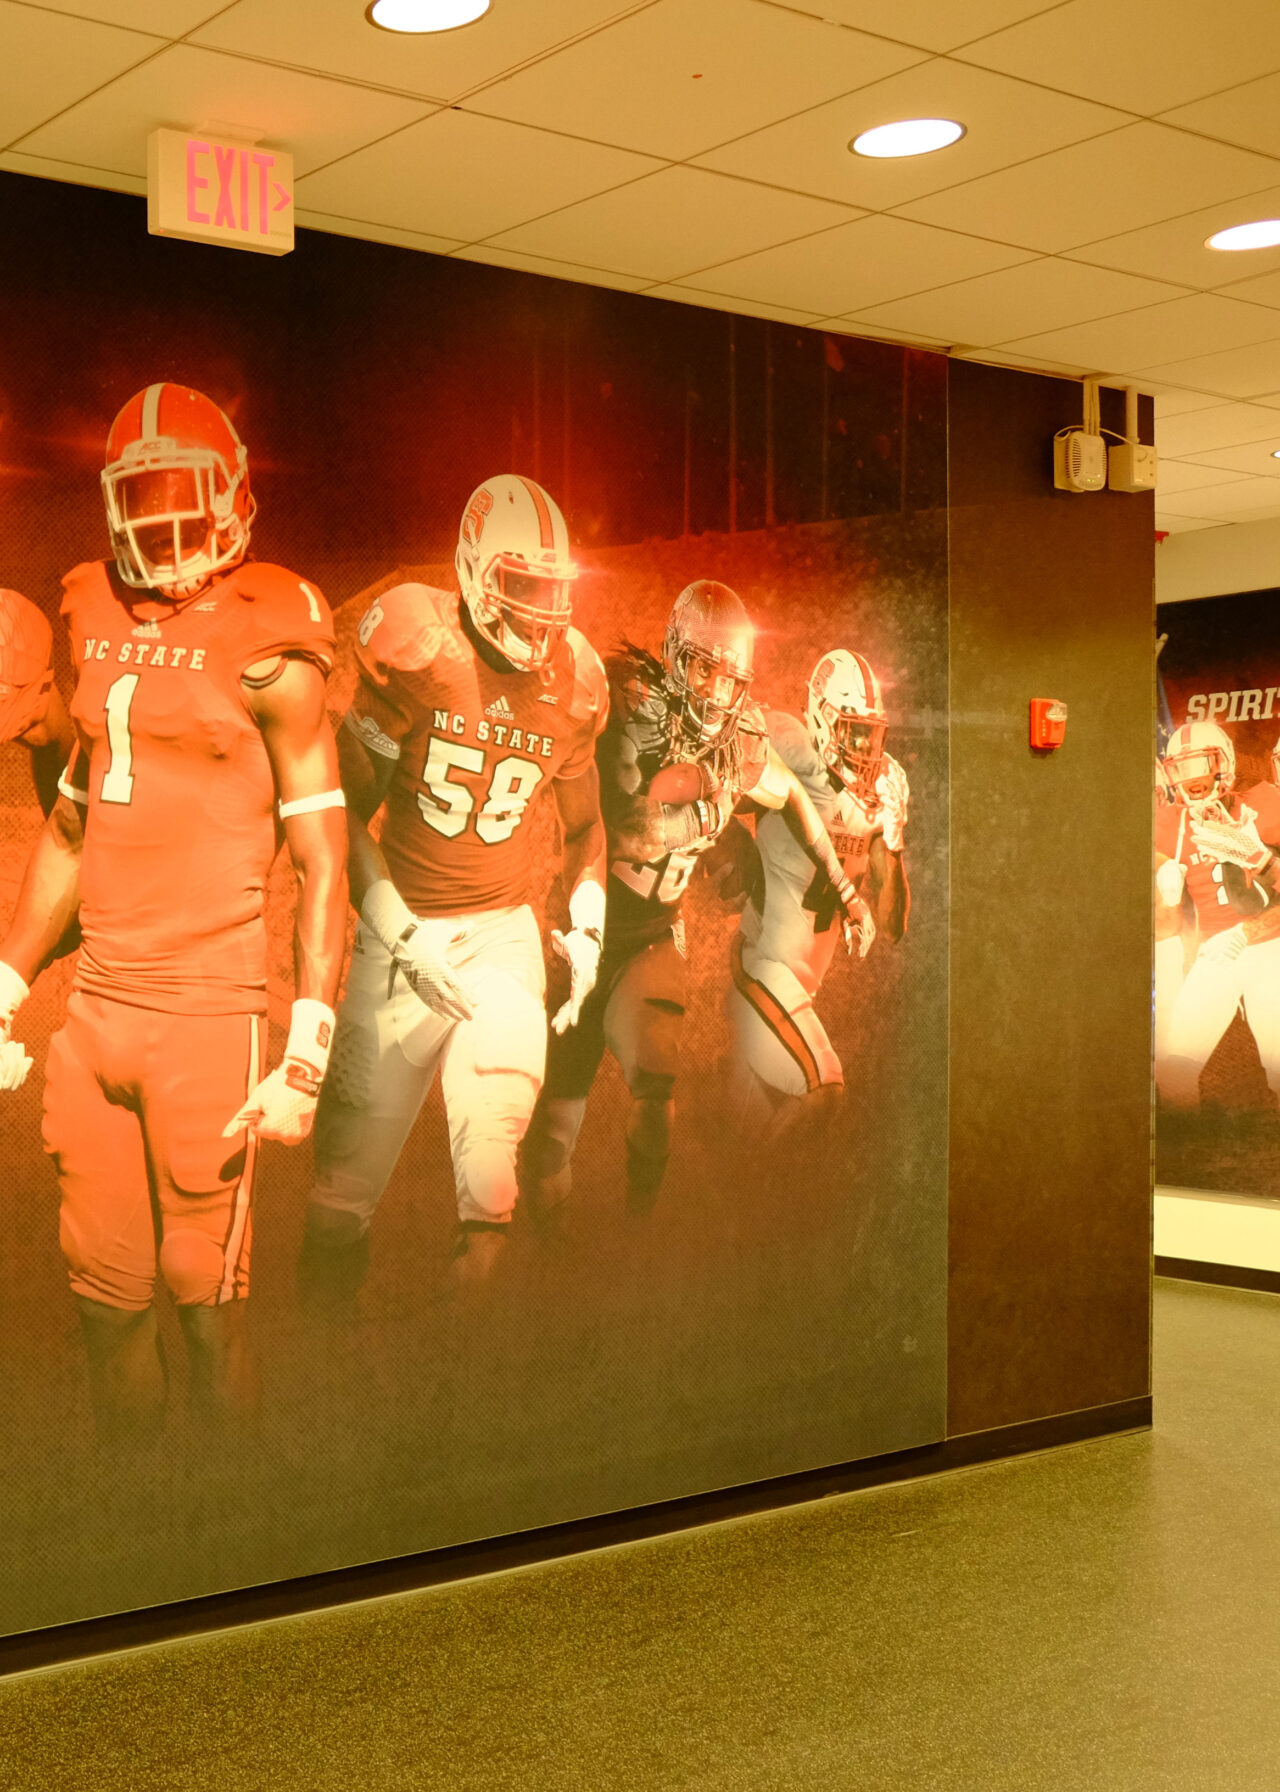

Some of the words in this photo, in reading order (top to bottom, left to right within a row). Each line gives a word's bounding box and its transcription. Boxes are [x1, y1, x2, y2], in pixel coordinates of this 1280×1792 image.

[186, 138, 276, 235] EXIT
[299, 582, 321, 622] 1
[83, 638, 111, 661] NC
[117, 642, 206, 670] STATE
[484, 707, 515, 721] adidas
[1185, 687, 1280, 724] SPIRI
[99, 672, 140, 805] 1
[432, 709, 466, 735] NC
[476, 720, 554, 757] STATE
[417, 736, 544, 845] 58
